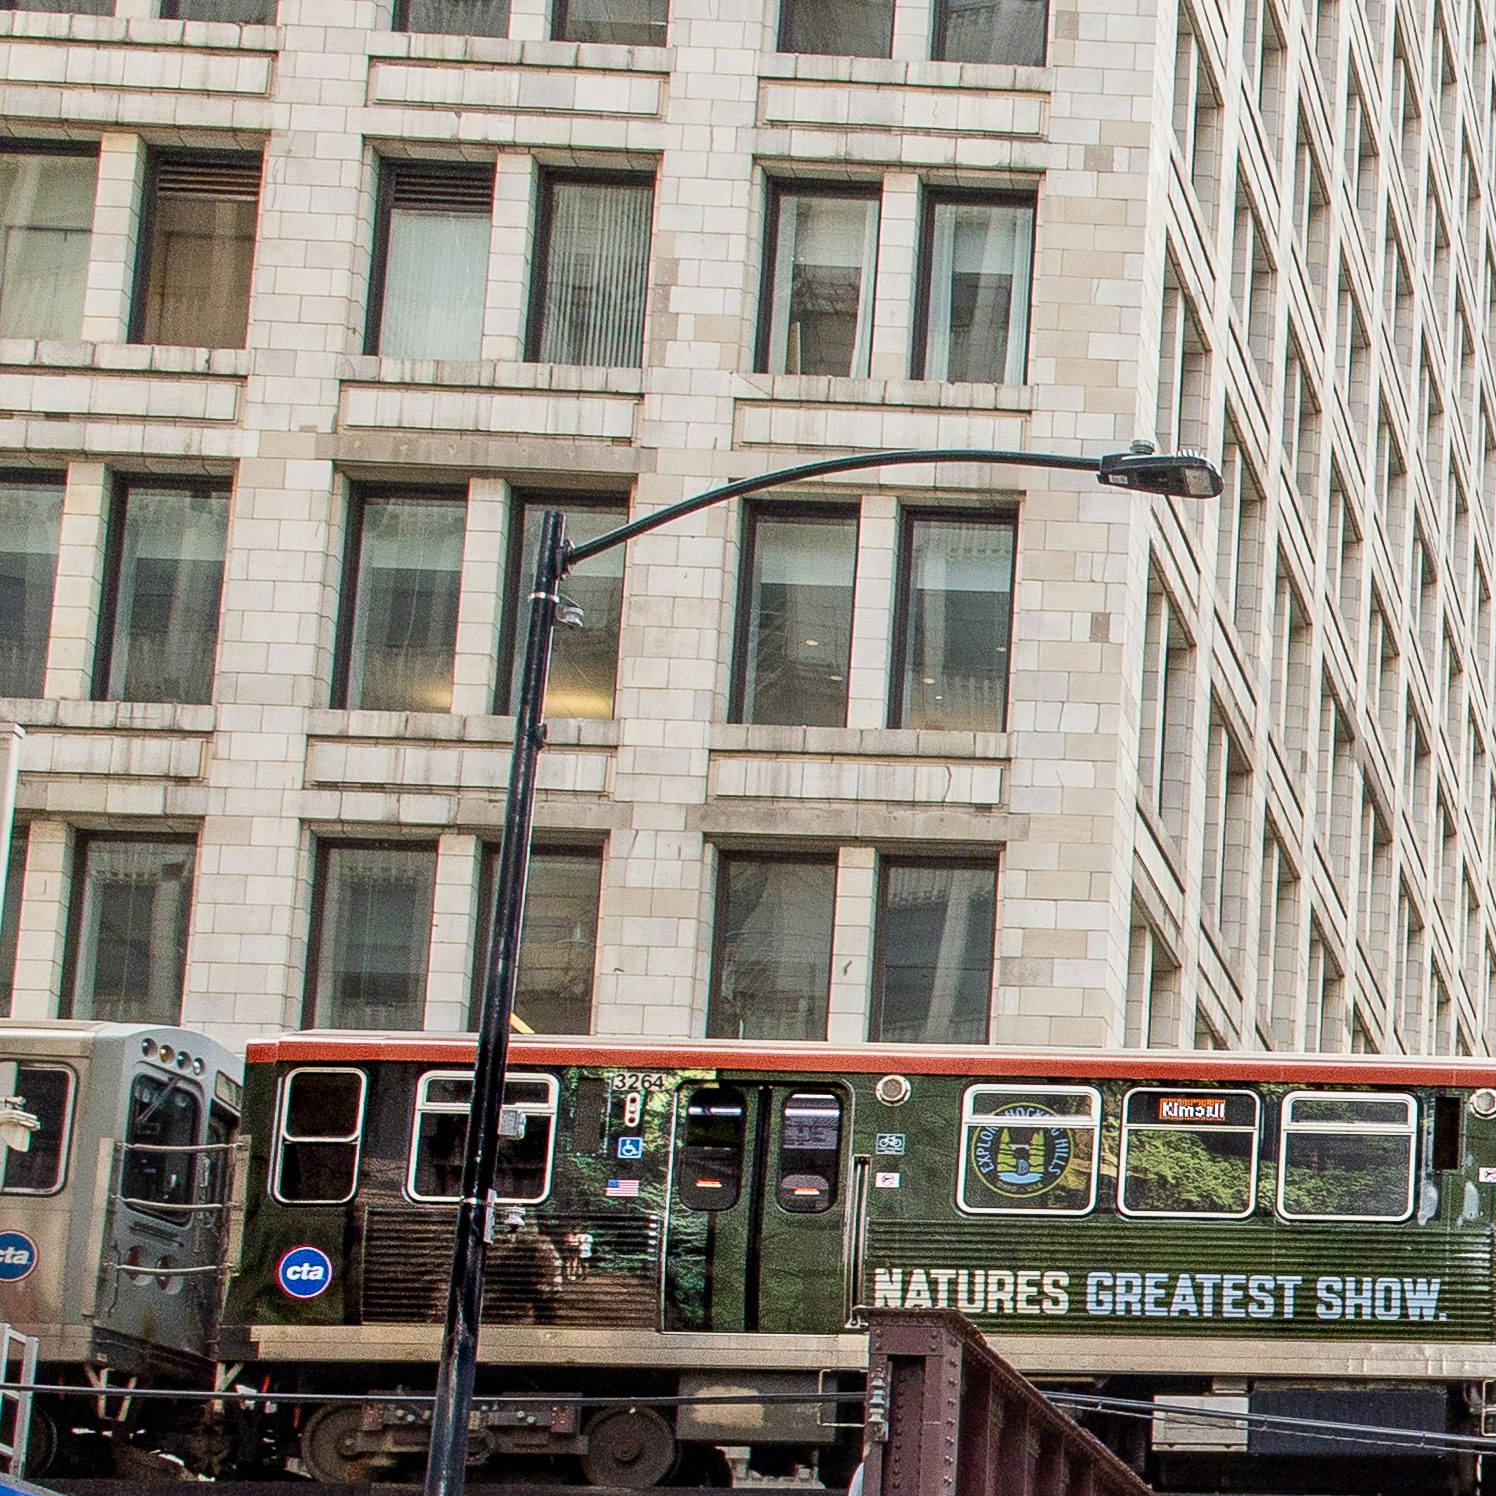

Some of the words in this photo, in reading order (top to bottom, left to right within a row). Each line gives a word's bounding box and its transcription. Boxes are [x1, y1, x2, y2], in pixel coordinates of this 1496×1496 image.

[615, 1074, 664, 1089] 3264
[1048, 1138, 1069, 1176] HILLS
[286, 1262, 324, 1281] cta
[874, 1268, 1070, 1315] NATURES
[1086, 1272, 1300, 1319] GREATEST
[1317, 1277, 1448, 1322] SHOW.
